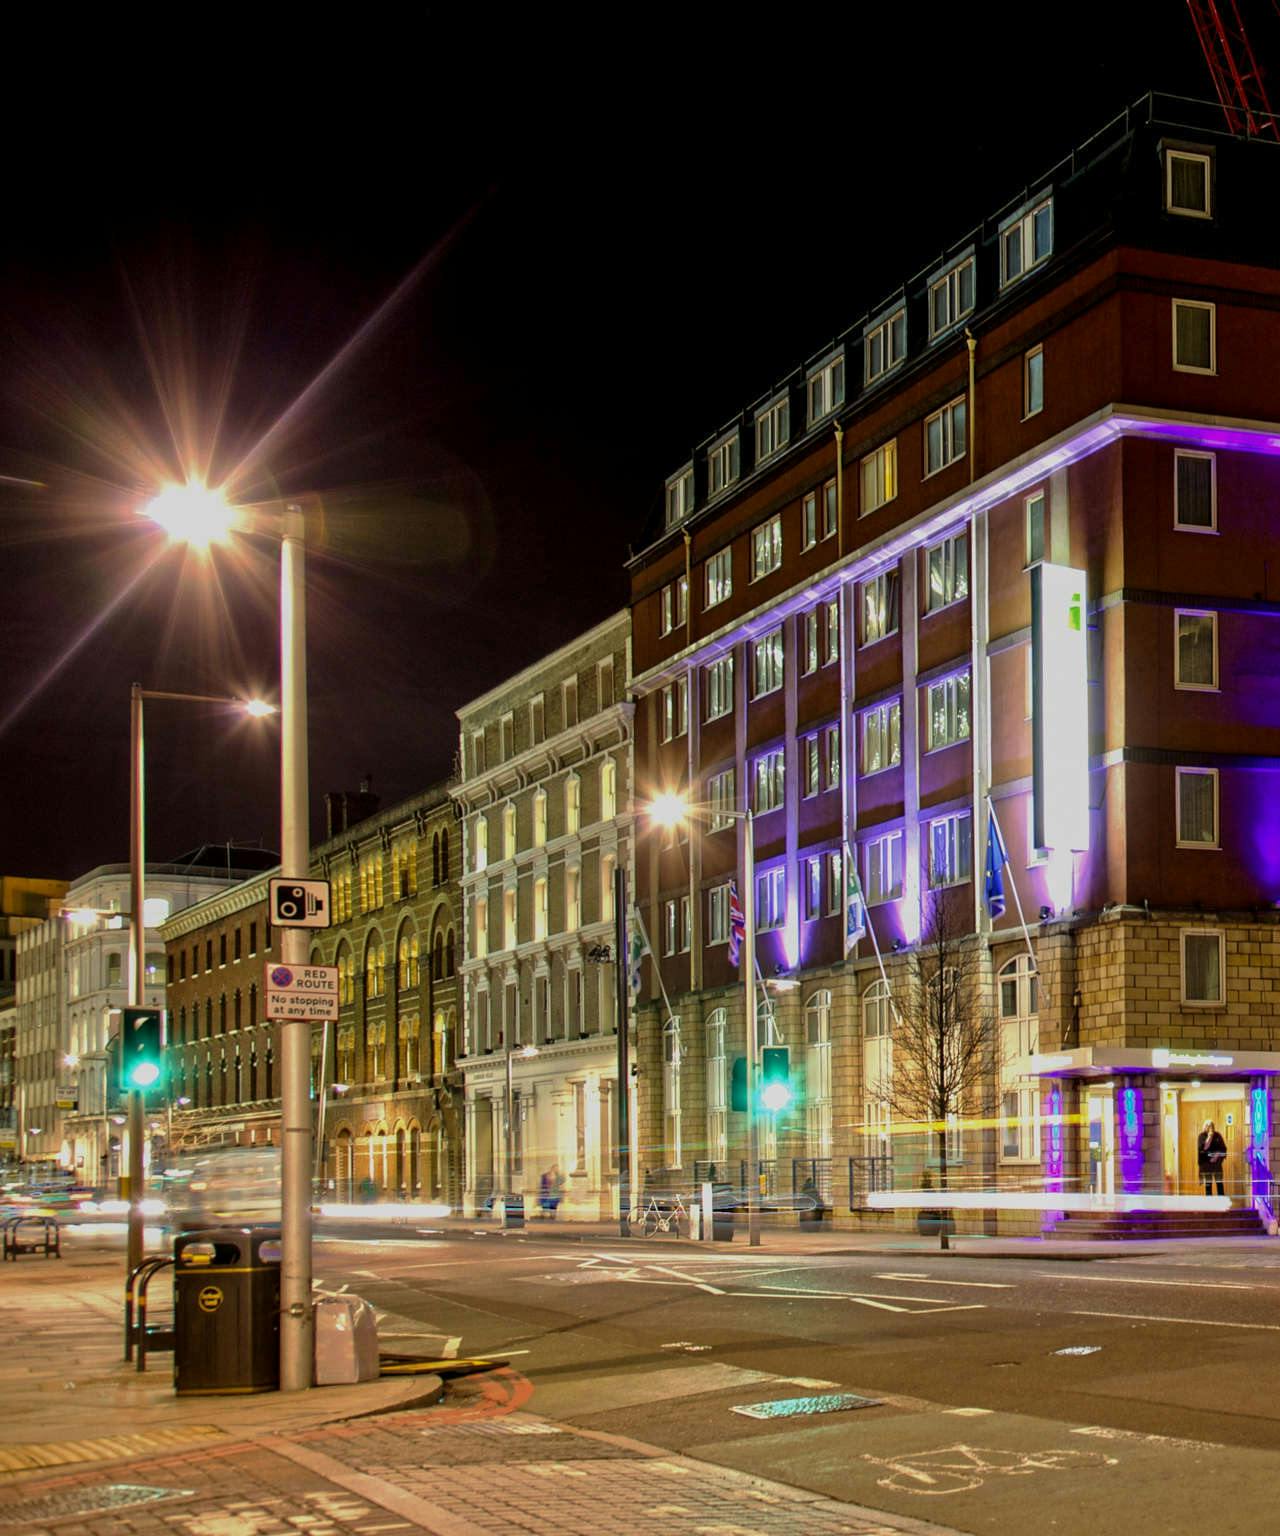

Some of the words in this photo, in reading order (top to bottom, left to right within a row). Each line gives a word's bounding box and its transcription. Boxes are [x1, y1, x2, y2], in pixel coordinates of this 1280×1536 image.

[304, 970, 327, 979] RED
[296, 979, 334, 989] ROUTE
[271, 995, 286, 1004] No
[290, 996, 334, 1007] stopping
[273, 1006, 284, 1014] at
[288, 1007, 306, 1016] any
[309, 1007, 332, 1016] time
